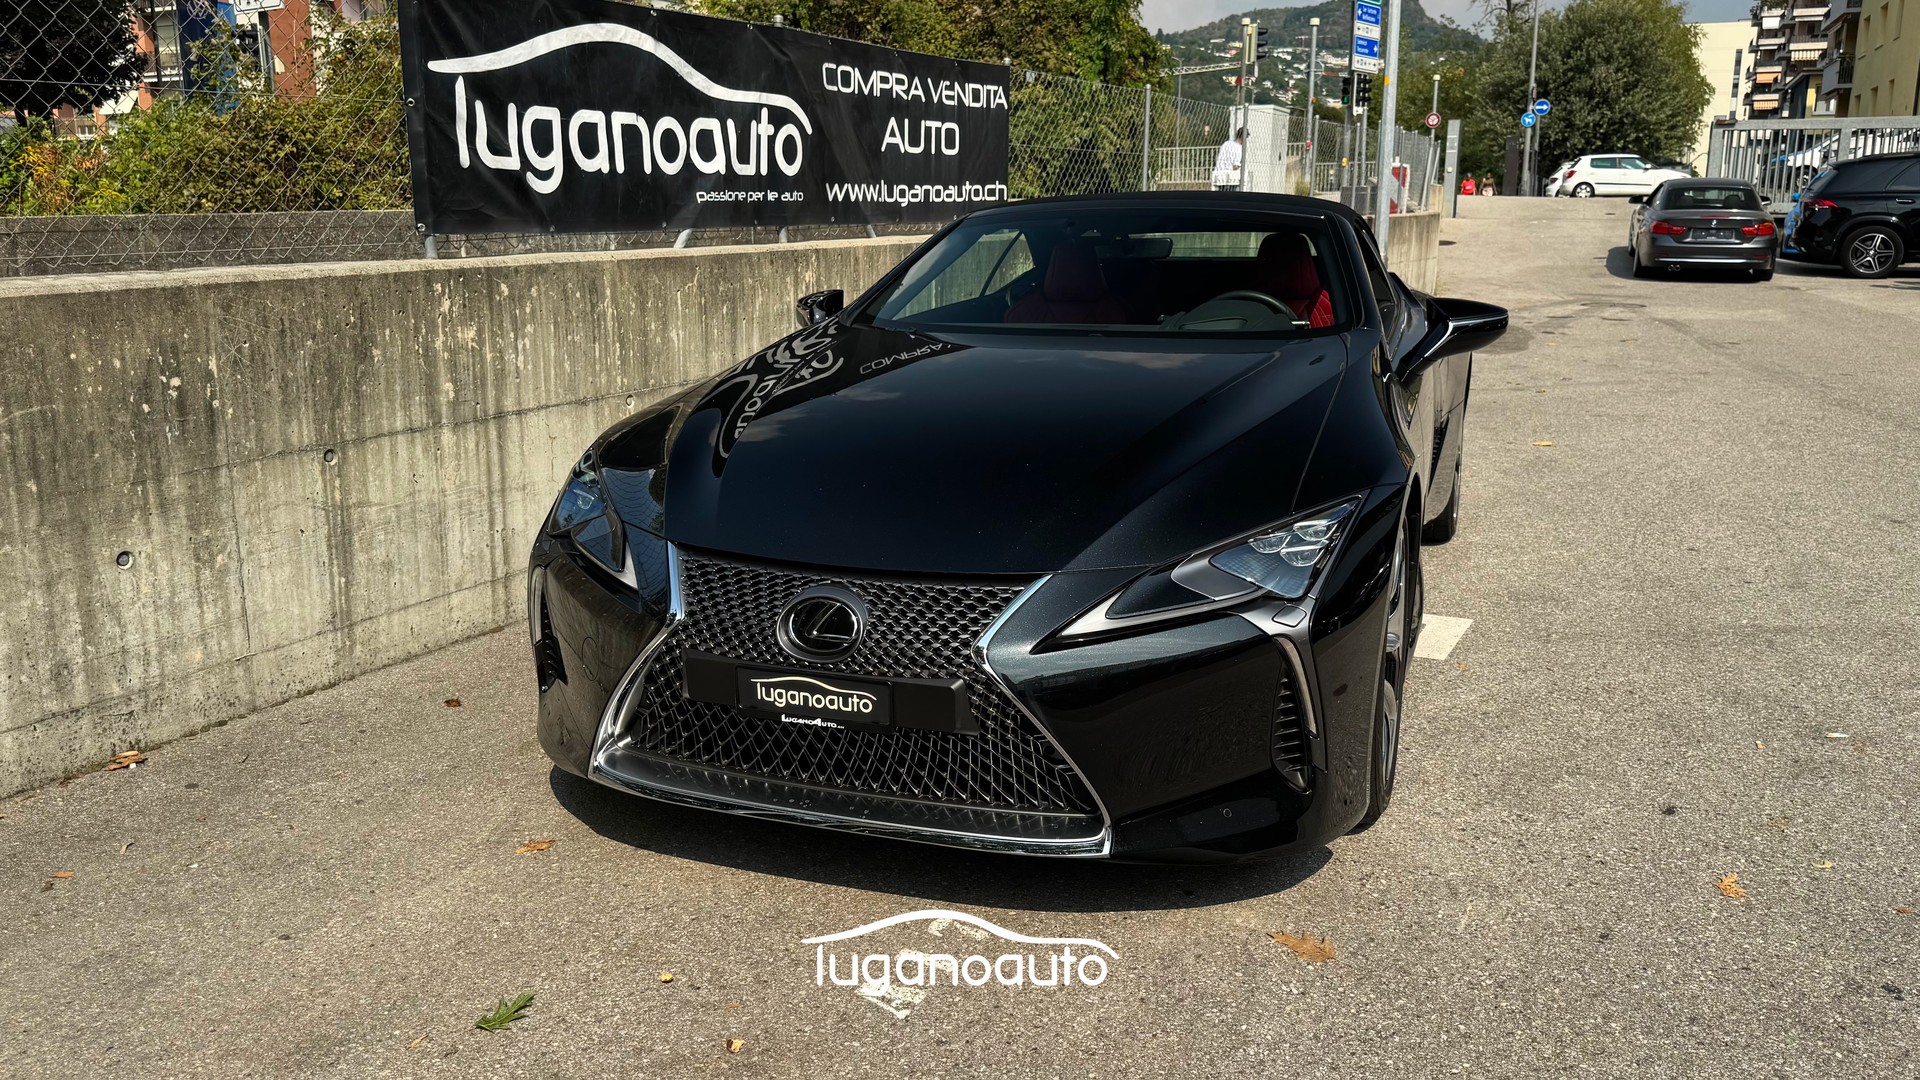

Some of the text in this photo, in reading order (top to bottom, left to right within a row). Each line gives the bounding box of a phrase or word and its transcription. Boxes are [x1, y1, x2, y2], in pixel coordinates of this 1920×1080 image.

[822, 62, 1008, 110] COMPRA VENDITA
[454, 75, 803, 194] luganoauto
[881, 116, 960, 155] AUTO
[696, 189, 804, 204] passione per le auto
[825, 180, 1007, 207] www.luganoauto.ch
[756, 682, 873, 713] luganoauto
